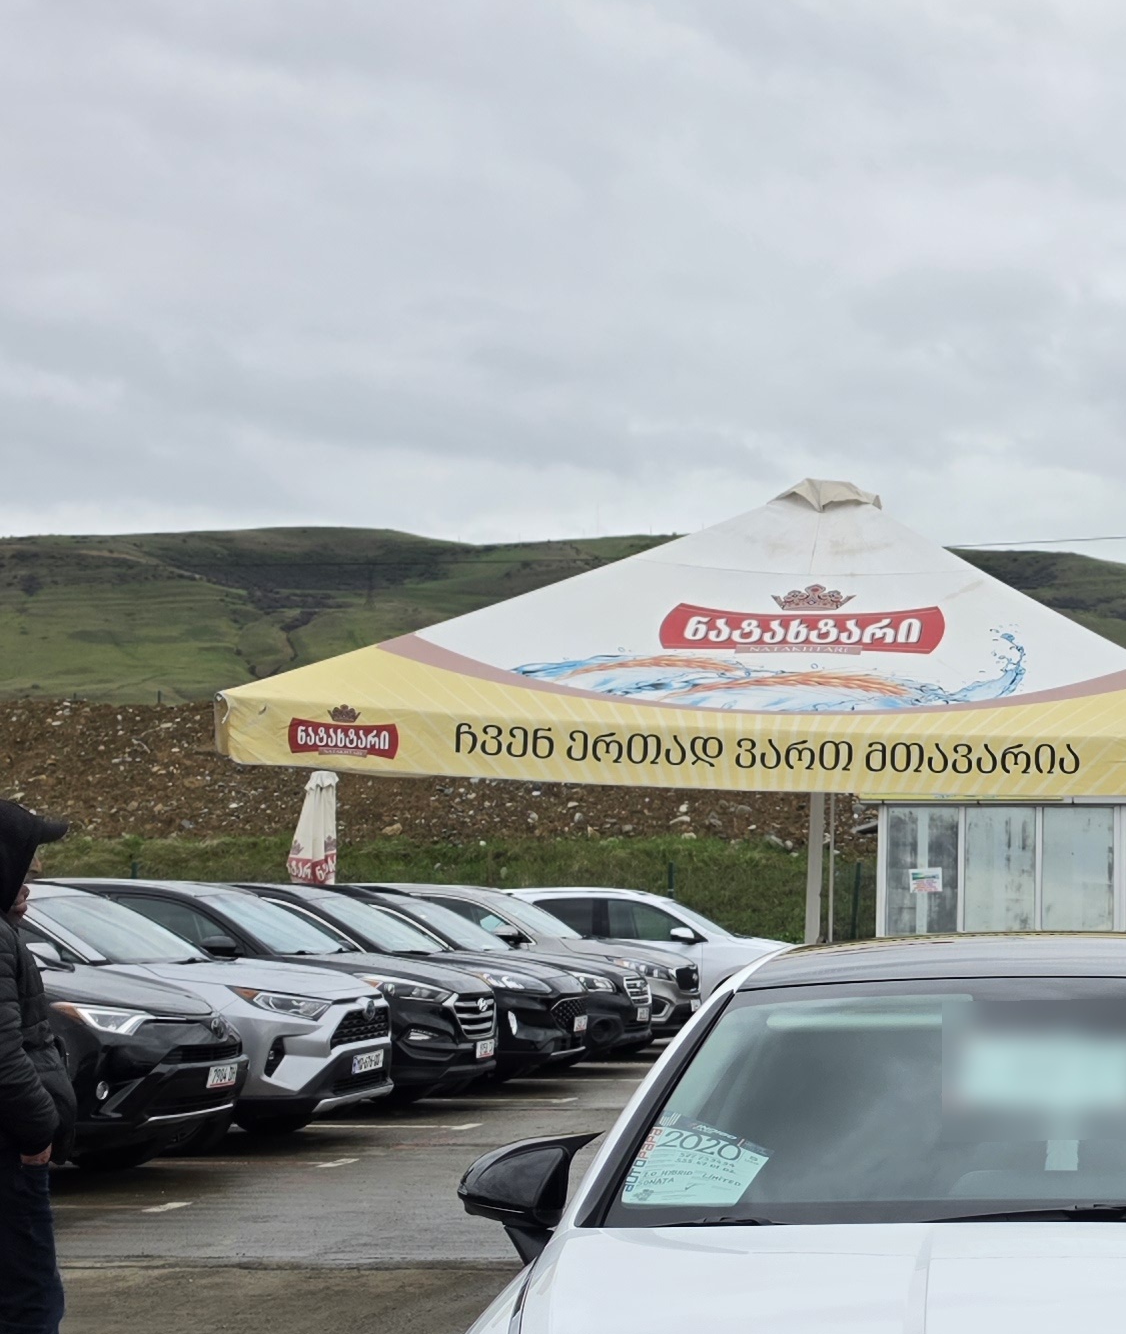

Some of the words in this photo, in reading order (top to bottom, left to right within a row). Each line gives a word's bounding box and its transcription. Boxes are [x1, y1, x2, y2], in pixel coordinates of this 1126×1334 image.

[684, 616, 921, 644] ნატახტარი
[297, 725, 389, 750] ნატახტარი
[455, 722, 554, 759] ჩვენ
[566, 730, 724, 767] ერთად
[735, 738, 852, 771] ვართ
[865, 741, 1080, 774] მთავარია
[656, 1130, 741, 1160] 2020
